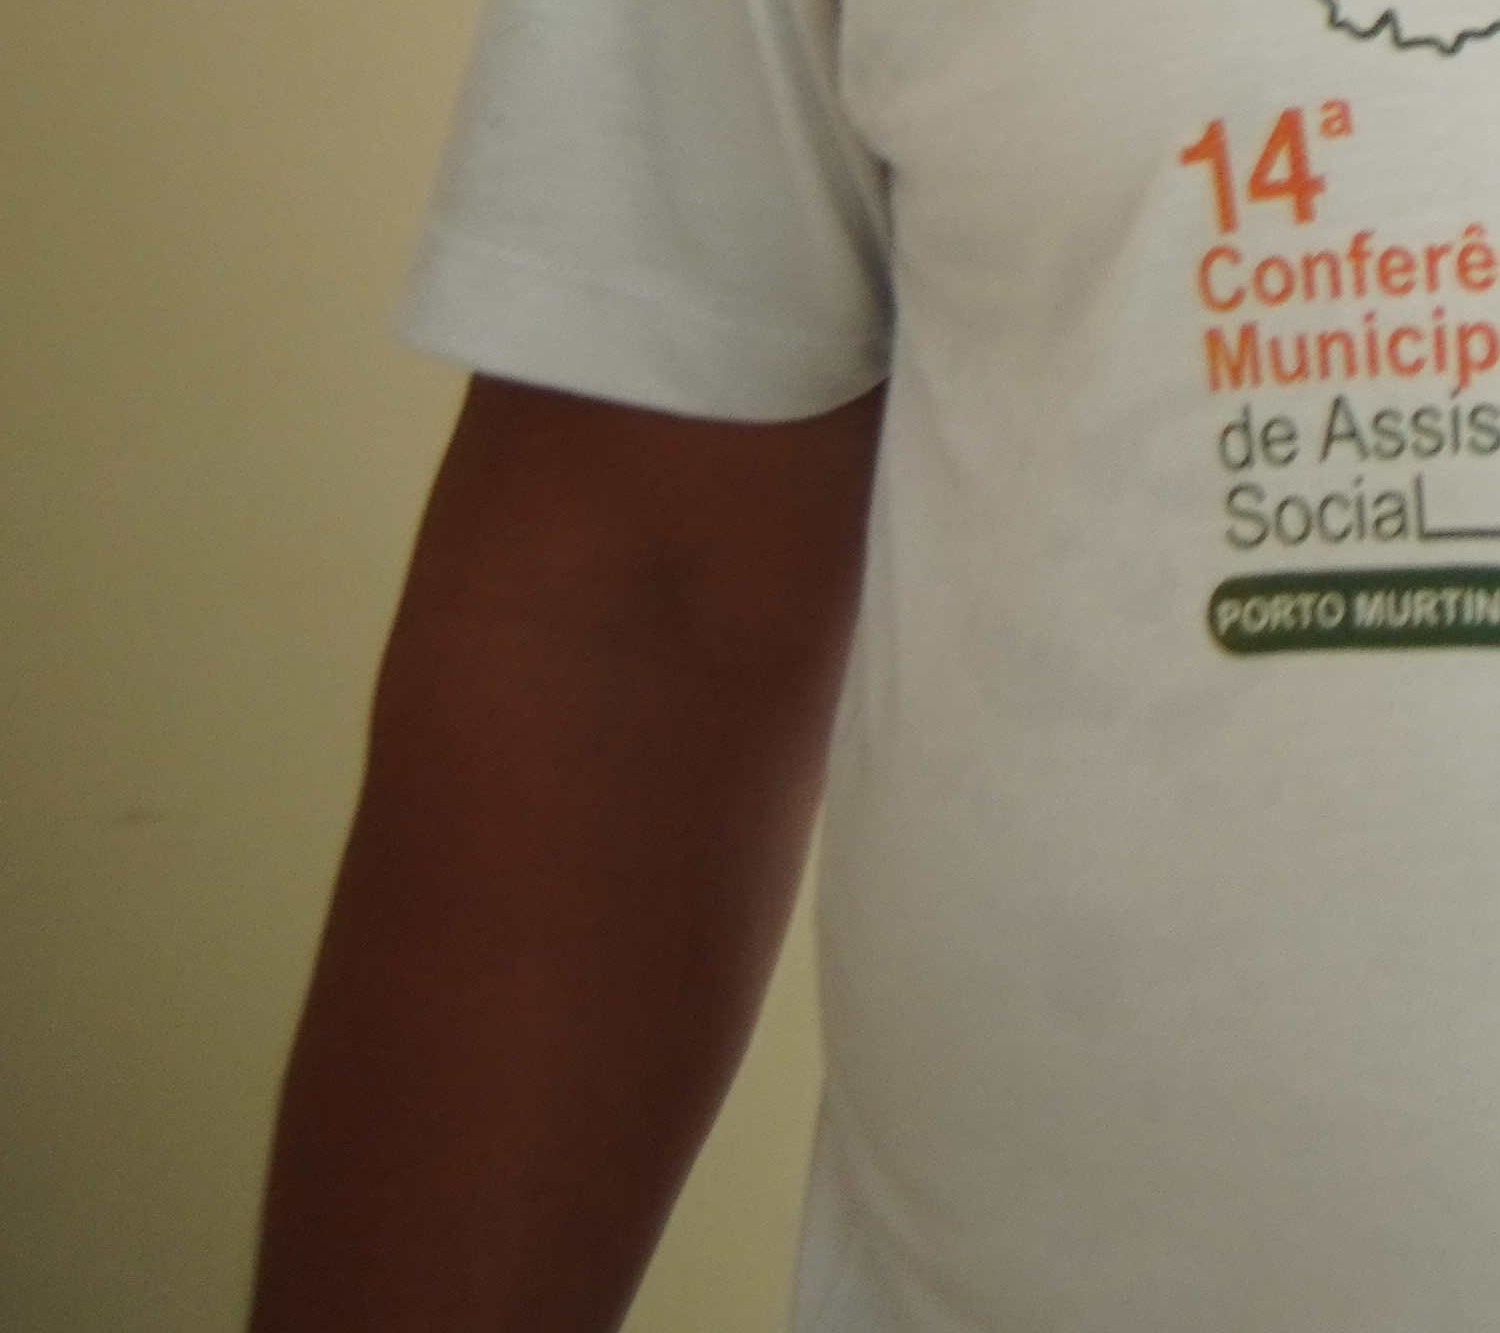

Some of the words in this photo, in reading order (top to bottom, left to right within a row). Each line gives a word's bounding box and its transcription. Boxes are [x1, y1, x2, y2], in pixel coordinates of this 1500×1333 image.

[1217, 403, 1299, 472] de
[1223, 472, 1427, 550] Social
[1216, 590, 1346, 636] PORTO
